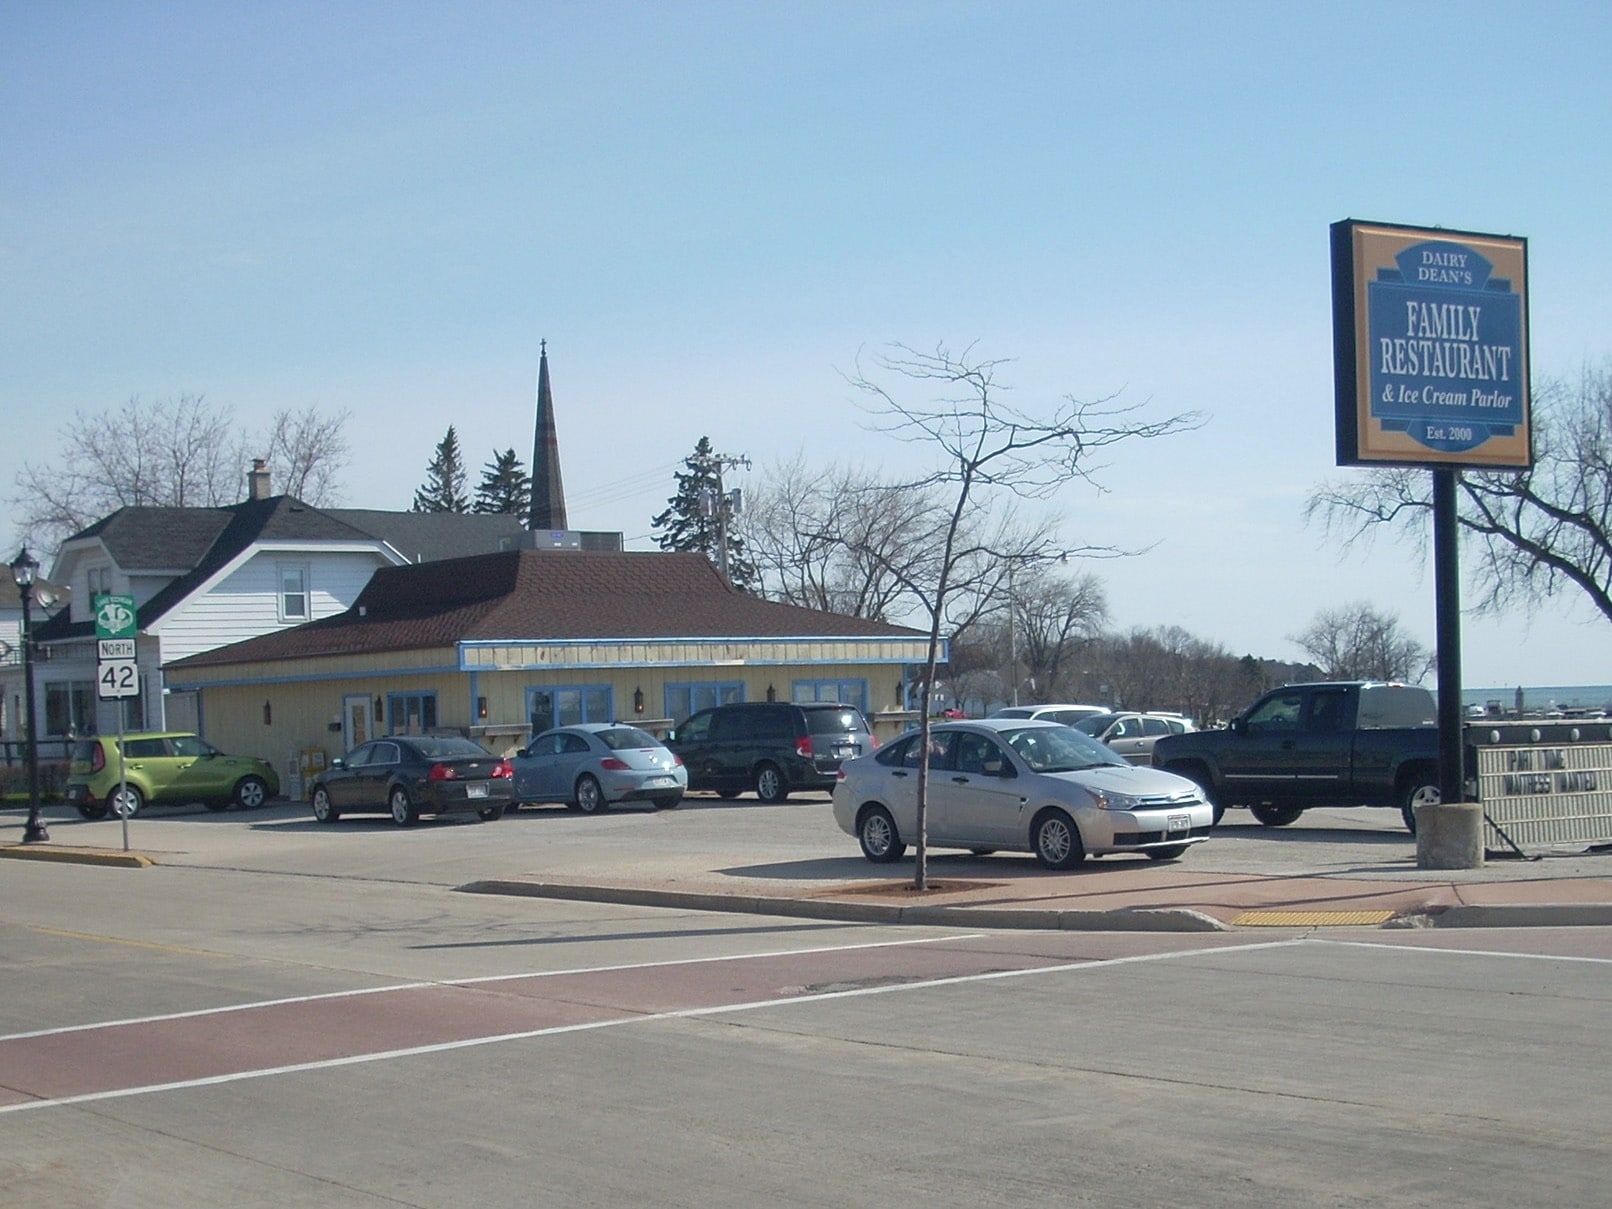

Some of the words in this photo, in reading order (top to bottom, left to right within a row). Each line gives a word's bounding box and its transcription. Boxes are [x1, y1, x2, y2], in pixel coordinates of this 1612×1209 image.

[1422, 251, 1468, 267] DAIRY
[1418, 267, 1472, 285] DEAN'S
[1406, 301, 1481, 341] FAMILY
[1380, 338, 1511, 381] RESTAURANT
[1382, 384, 1394, 402] &
[1398, 385, 1419, 403] Ice
[1422, 387, 1467, 405] Cream
[1470, 388, 1512, 408] Parlor
[1426, 426, 1447, 440] Est.
[1448, 427, 1472, 441] 2000
[101, 642, 133, 656] NORTH
[101, 666, 134, 688] 42
